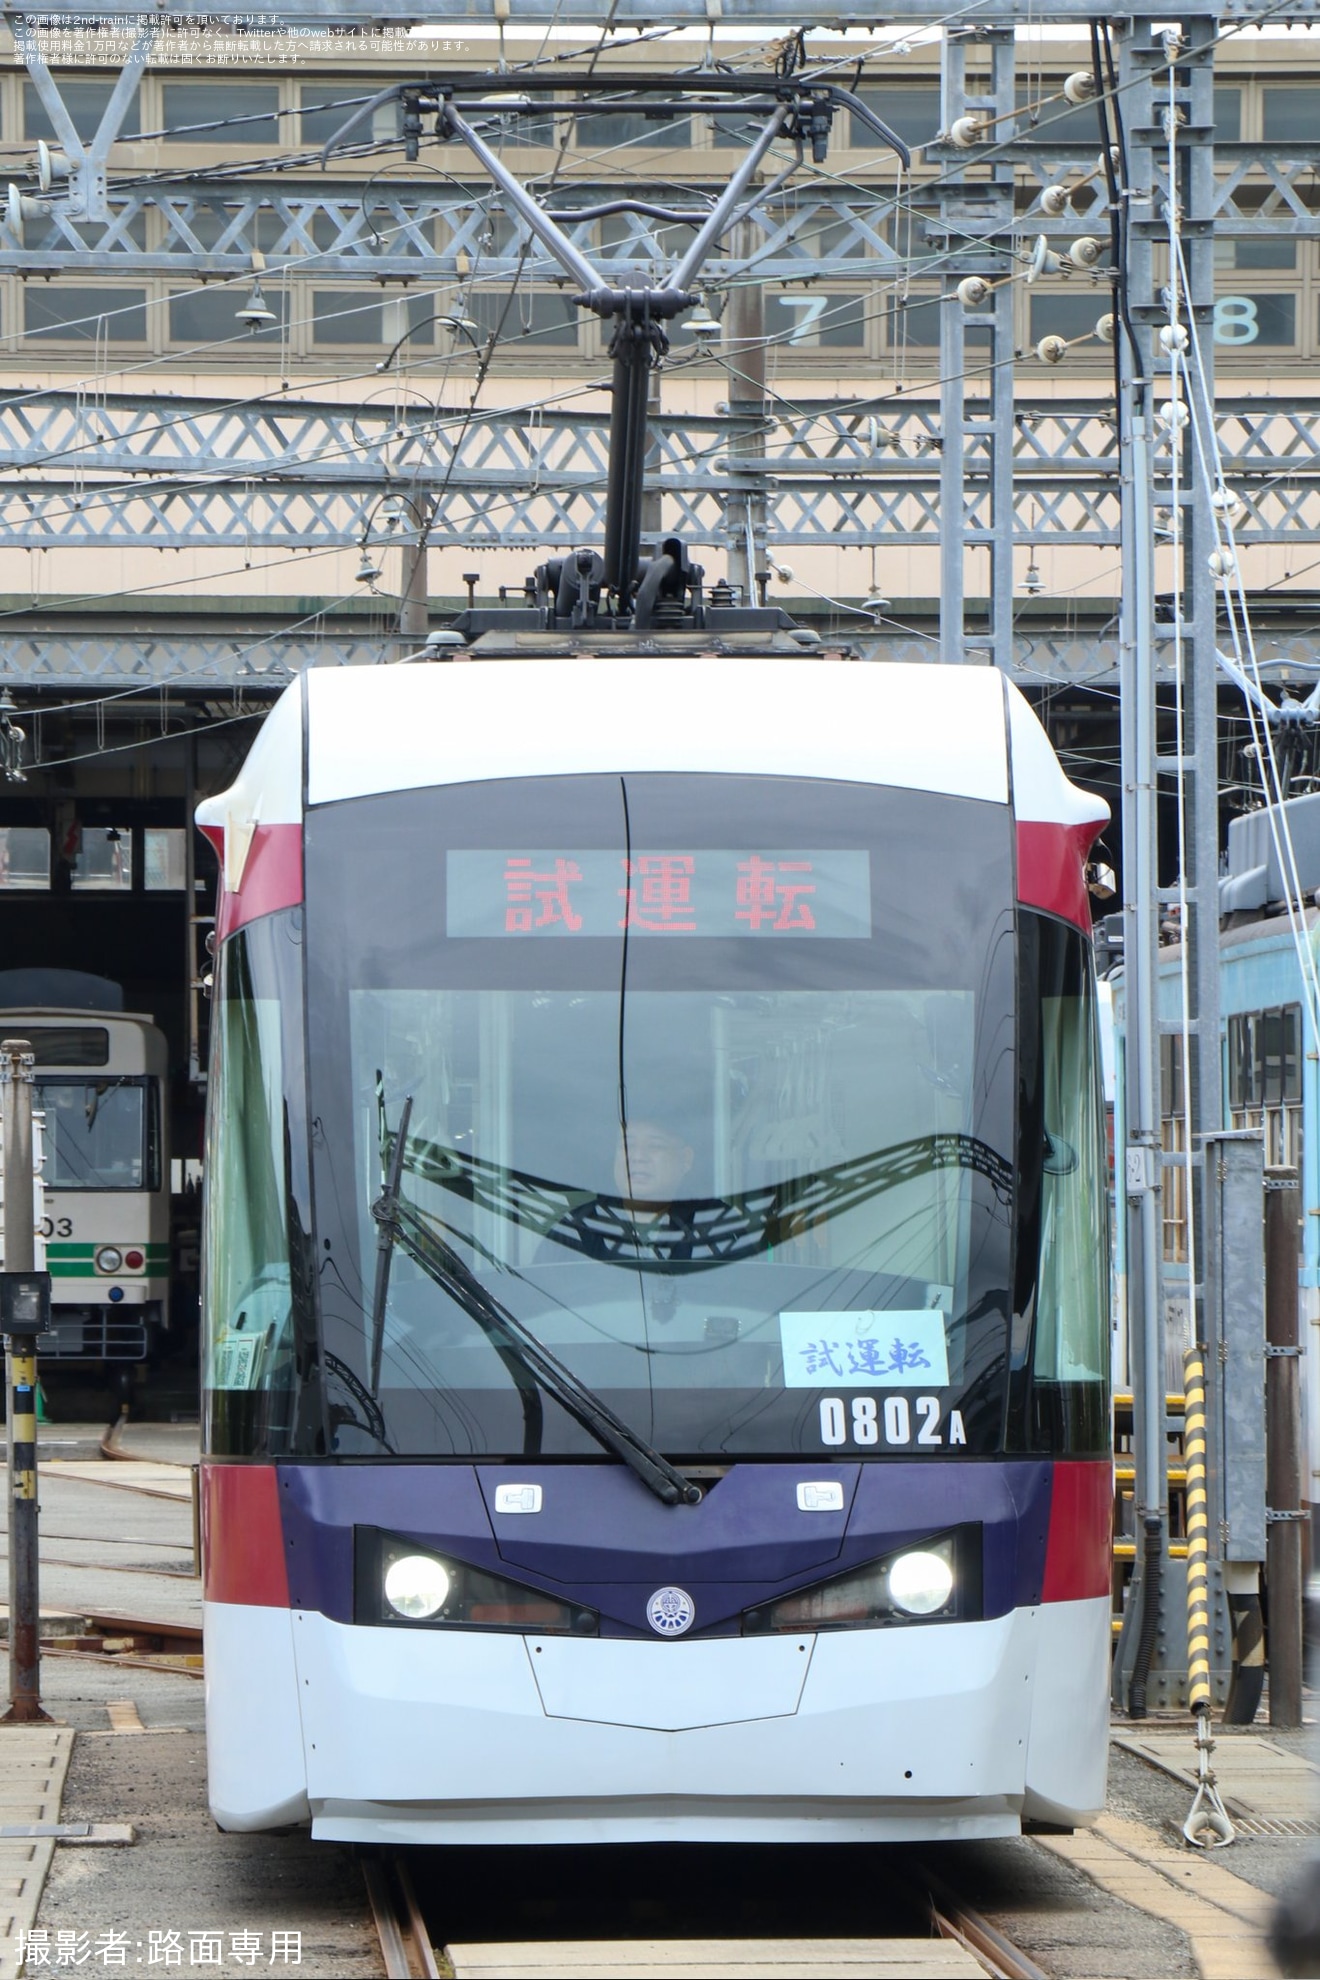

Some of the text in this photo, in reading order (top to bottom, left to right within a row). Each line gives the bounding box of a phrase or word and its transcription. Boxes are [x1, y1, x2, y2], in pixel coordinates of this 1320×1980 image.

[779, 295, 828, 346] 7
[1213, 295, 1259, 346] 8
[503, 855, 816, 931] 試運転
[799, 1338, 932, 1377] 試運転
[819, 1396, 967, 1446] 0802A
